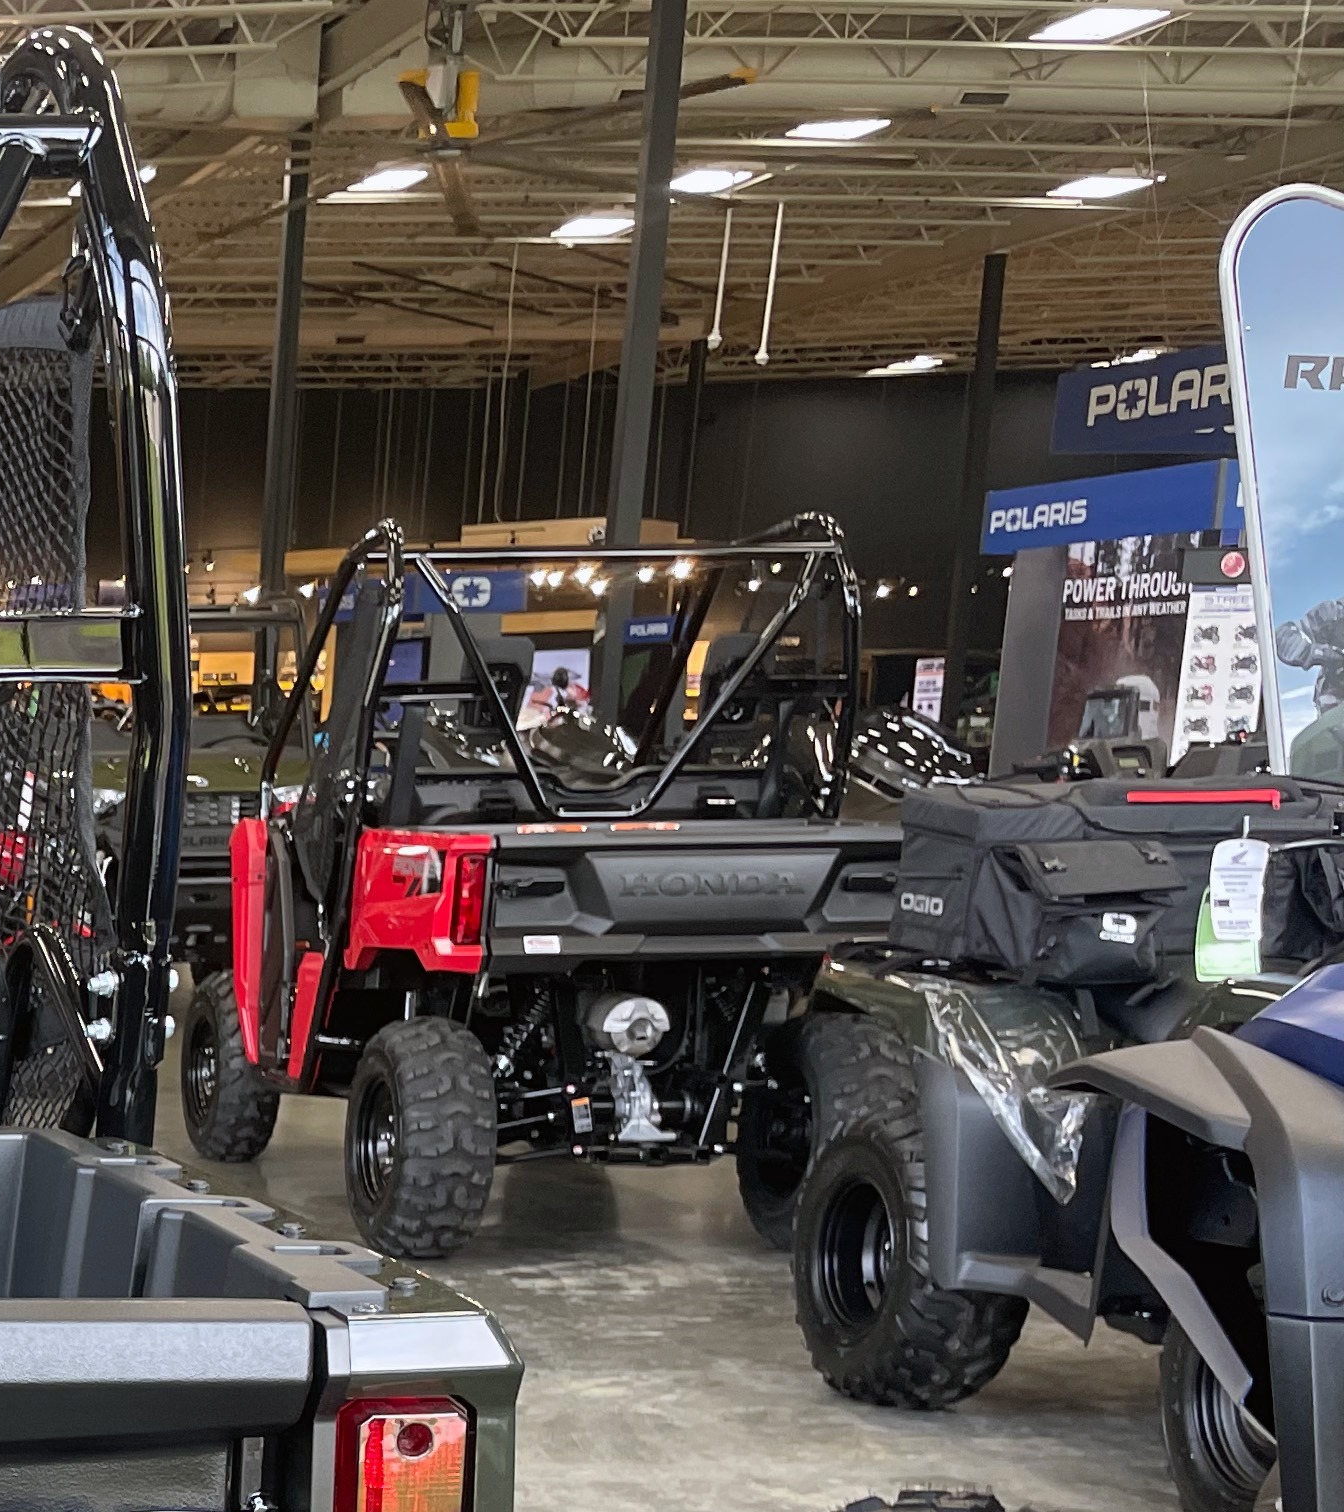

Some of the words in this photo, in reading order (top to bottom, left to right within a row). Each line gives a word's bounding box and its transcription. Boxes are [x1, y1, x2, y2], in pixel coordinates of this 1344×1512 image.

[1086, 363, 1231, 427] POLAR
[989, 498, 1088, 535] POLARIS
[1062, 577, 1116, 604] POWER
[1131, 602, 1148, 616] ANY
[1149, 600, 1187, 616] WEATHER
[618, 872, 805, 897] HONDA
[900, 892, 944, 917] OGIO
